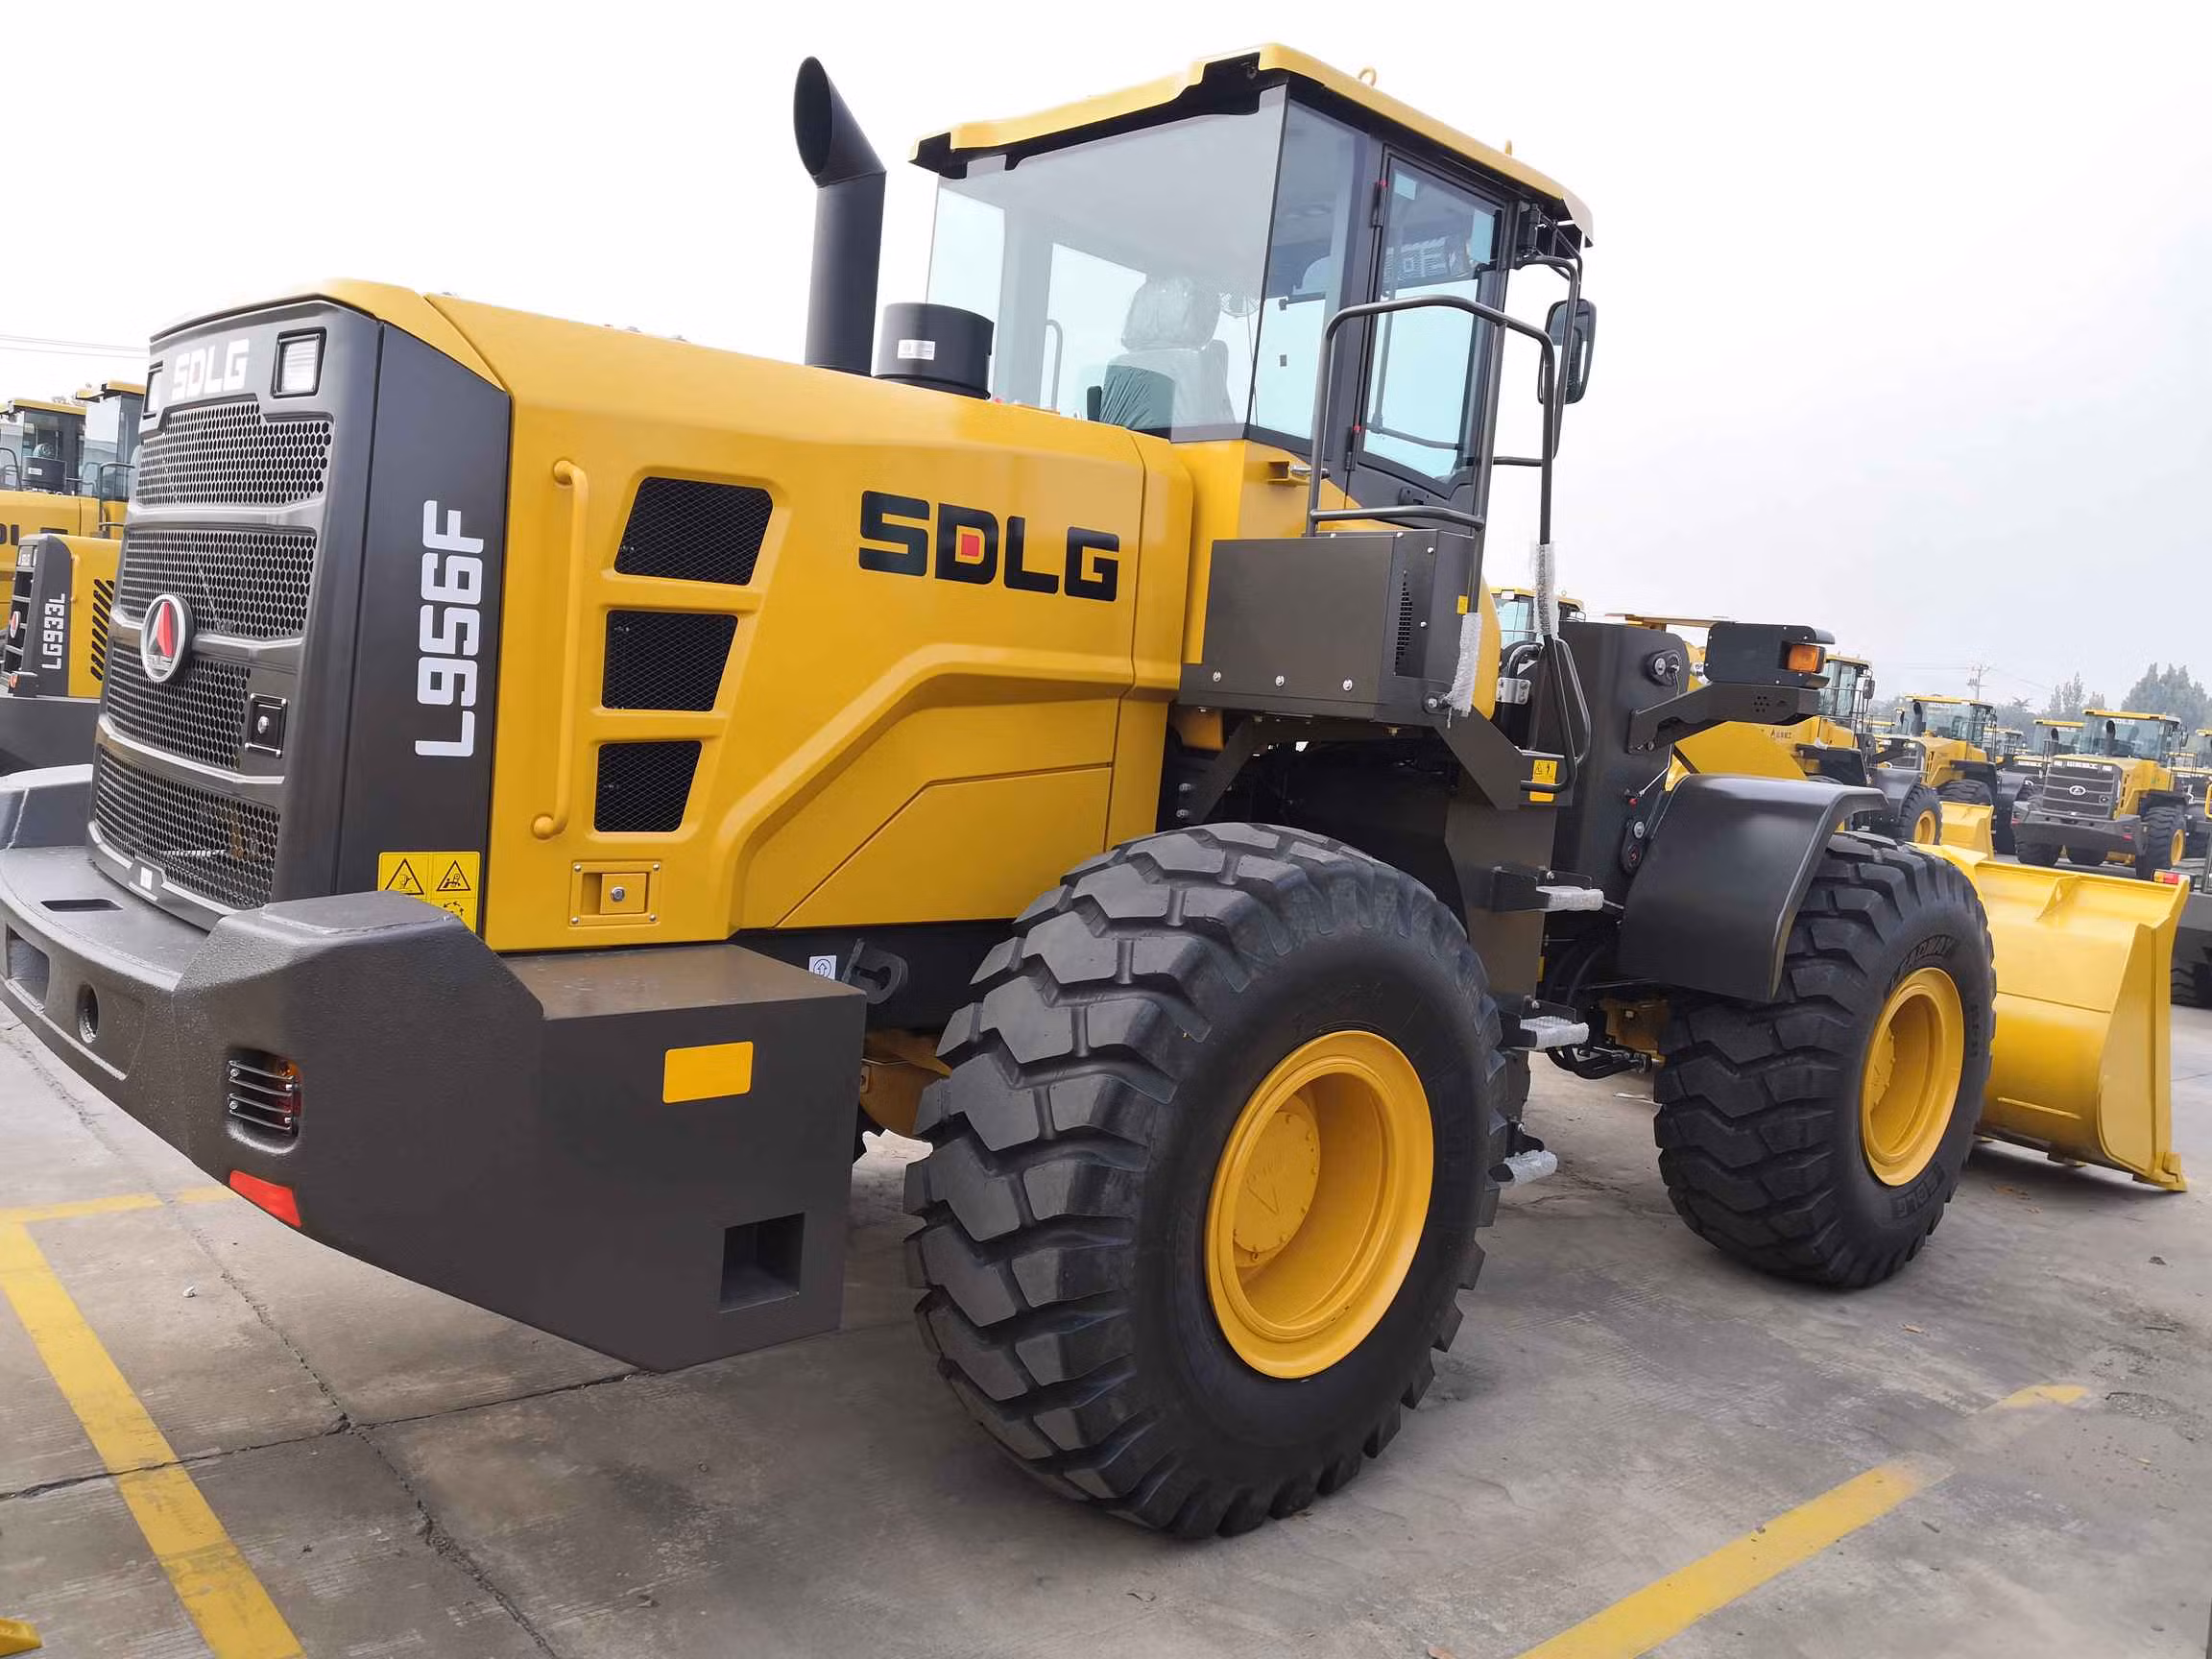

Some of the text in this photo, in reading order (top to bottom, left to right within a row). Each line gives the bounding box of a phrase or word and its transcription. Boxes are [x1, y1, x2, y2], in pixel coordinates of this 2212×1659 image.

[170, 339, 250, 401] SDLG
[859, 491, 1119, 602] SDLG
[41, 593, 65, 670] LG933L
[415, 500, 484, 757] L956F
